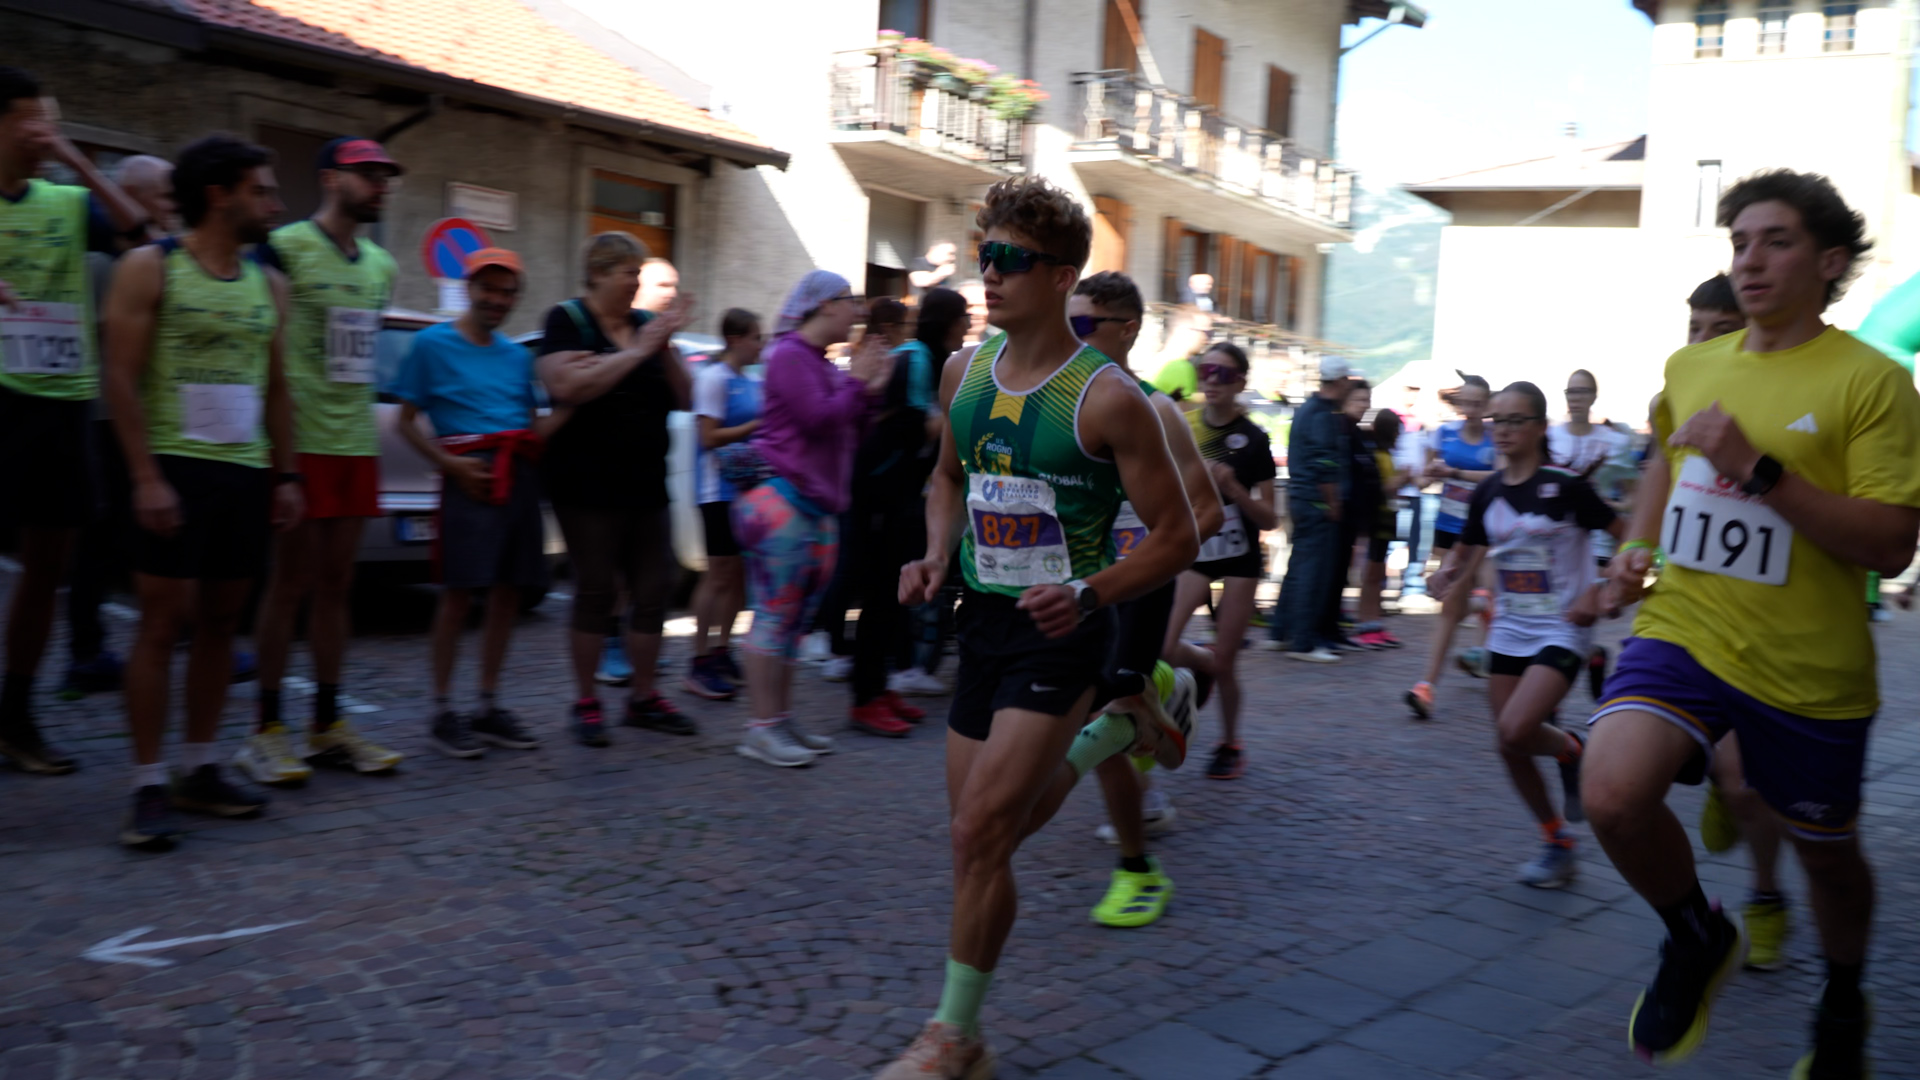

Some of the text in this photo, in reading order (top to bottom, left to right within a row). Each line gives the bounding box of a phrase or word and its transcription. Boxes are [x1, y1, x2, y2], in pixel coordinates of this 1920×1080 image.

[986, 442, 1012, 455] ROGNO
[1038, 473, 1084, 486] GLOBAL
[982, 514, 1040, 547] 827
[1668, 505, 1775, 576] 1191
